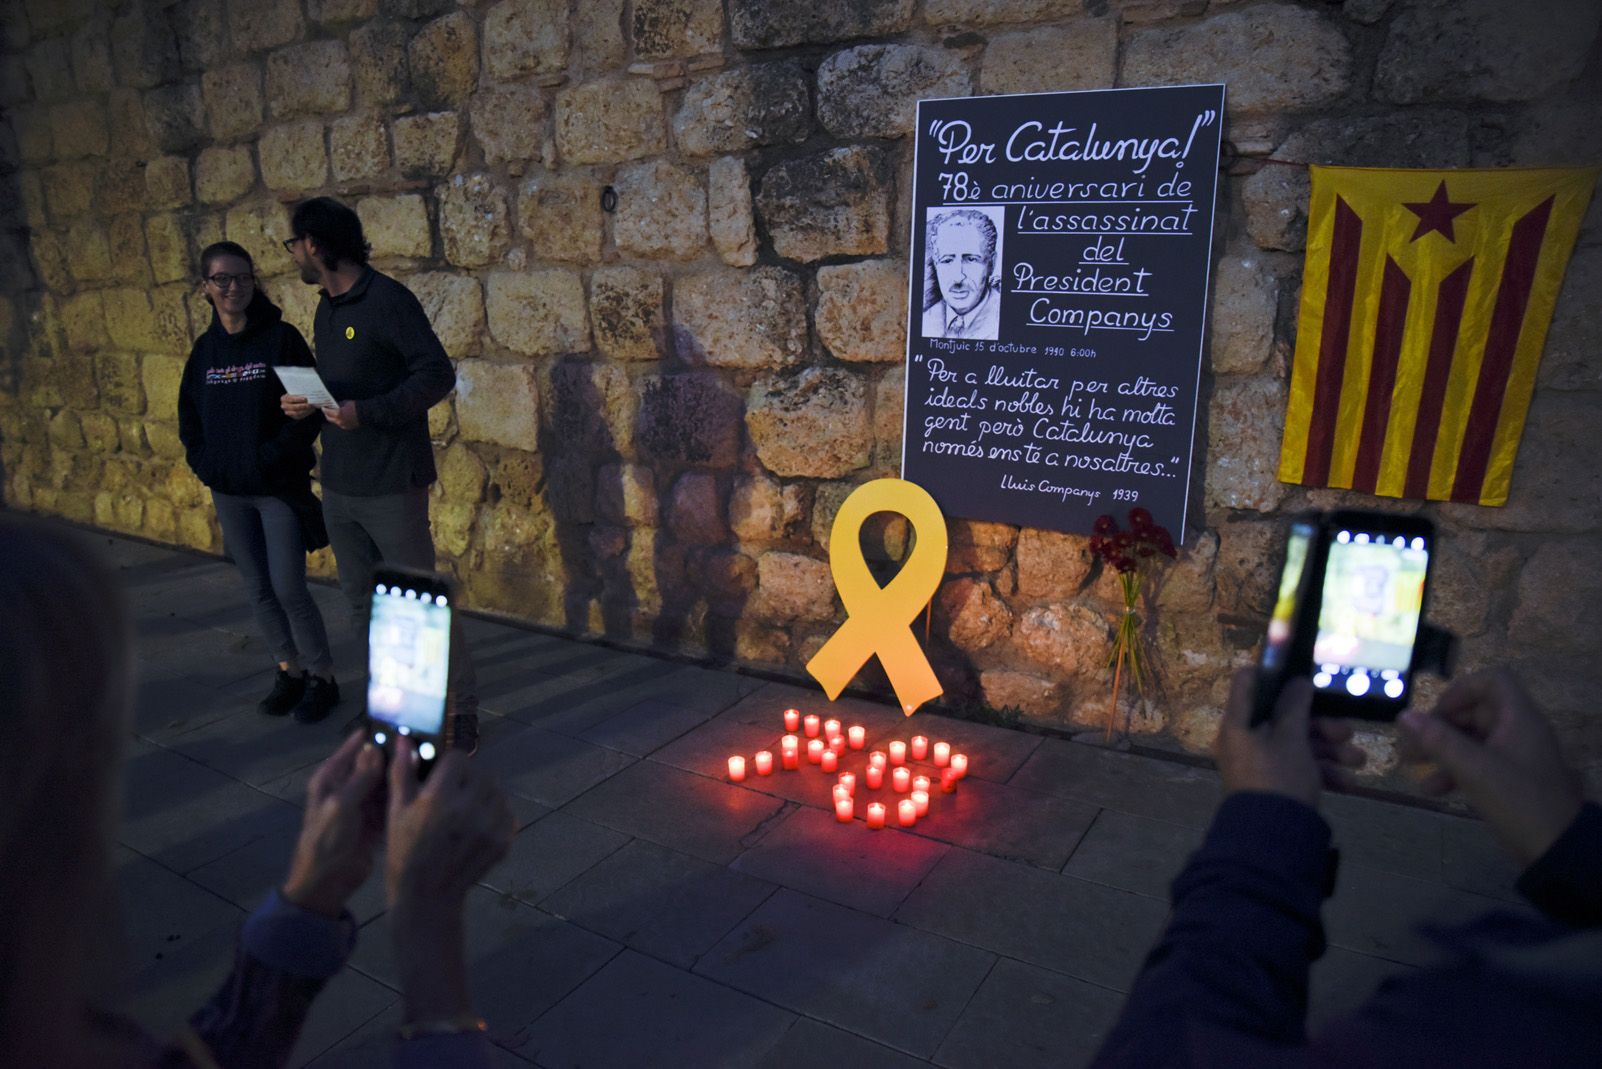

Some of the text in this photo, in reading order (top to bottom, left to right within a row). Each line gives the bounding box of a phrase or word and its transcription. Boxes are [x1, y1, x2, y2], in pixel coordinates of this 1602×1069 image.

[991, 175, 1146, 200] aniversari
[1157, 171, 1192, 197] de
[1082, 237, 1126, 262] del
[1013, 263, 1153, 293] President
[1029, 298, 1173, 341] Companys
[974, 341, 985, 352] 15
[964, 371, 978, 385] a
[985, 366, 1060, 390] lluitar
[1069, 378, 1108, 399] per
[1118, 376, 1179, 399] altres
[924, 387, 1176, 426] ideals nobles hi ha molta
[924, 413, 1154, 456] gent però Catalunya
[922, 440, 984, 459] només
[1045, 453, 1059, 467] a
[1038, 481, 1101, 506] Companys
[1112, 489, 1139, 502] 1939
